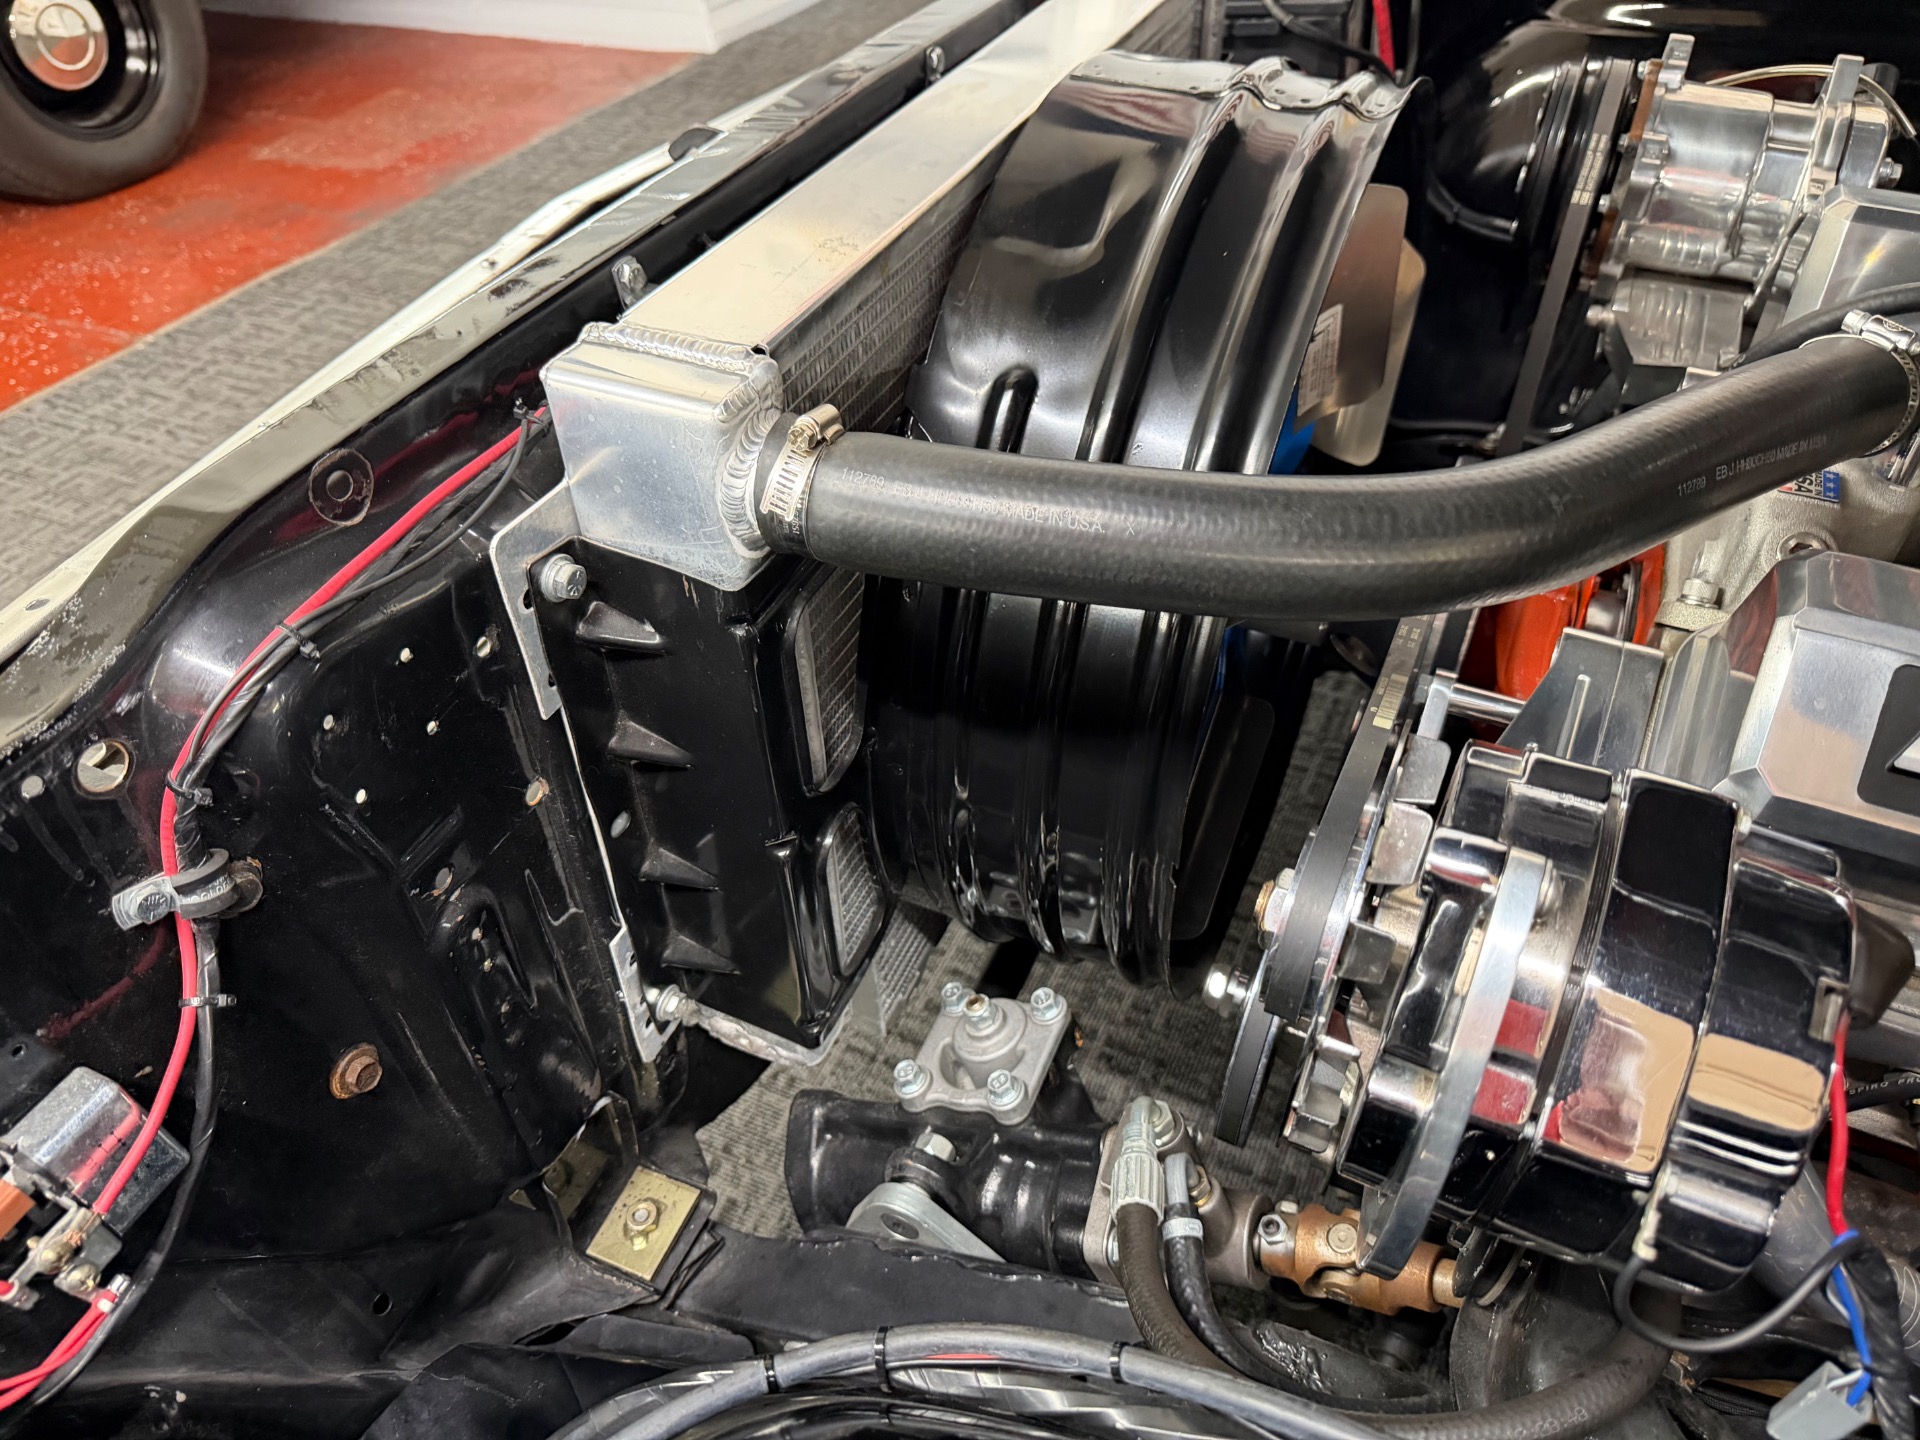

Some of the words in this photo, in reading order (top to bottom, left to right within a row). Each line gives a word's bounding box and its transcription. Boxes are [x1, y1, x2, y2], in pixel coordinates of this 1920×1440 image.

[840, 466, 886, 491] 112789
[1677, 476, 1706, 497] 112789
[1793, 473, 1814, 494] SA
[1047, 509, 1064, 528] IN
[1849, 1081, 1888, 1095] SPIRO
